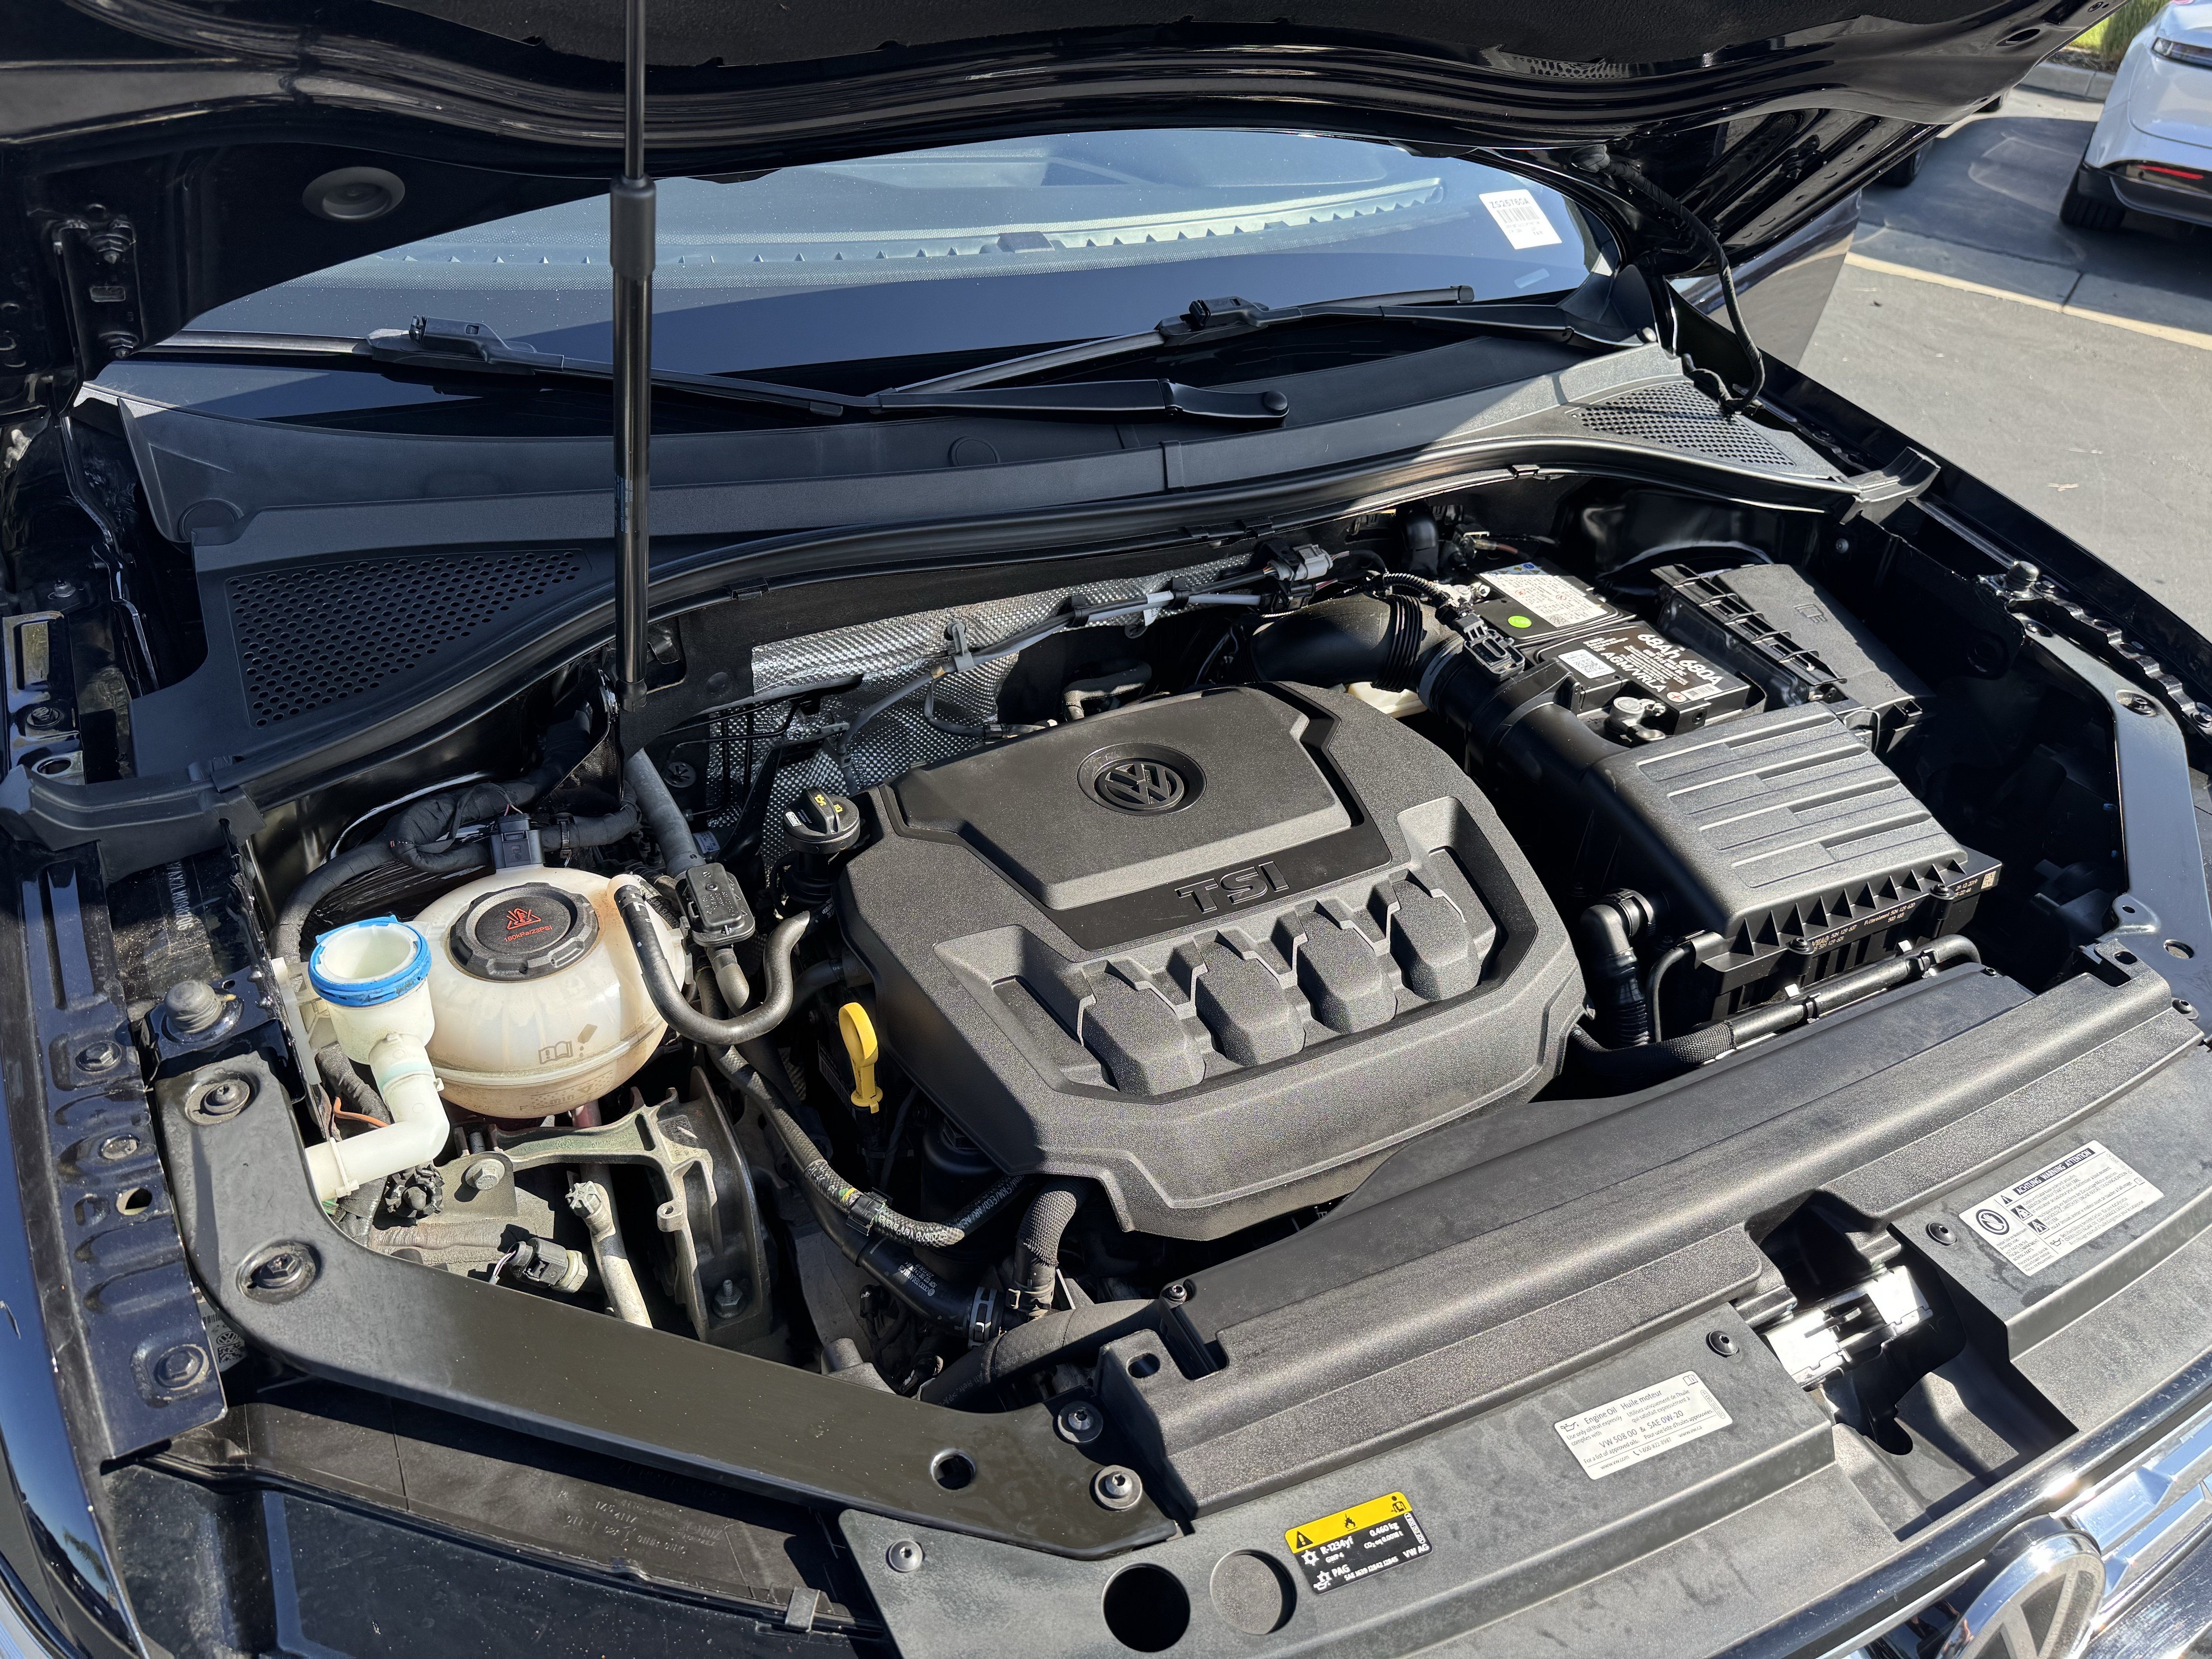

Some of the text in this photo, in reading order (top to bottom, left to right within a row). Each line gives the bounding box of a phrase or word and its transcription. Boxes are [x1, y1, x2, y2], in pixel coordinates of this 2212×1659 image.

[1637, 634, 1681, 659] 68Ah
[1679, 659, 1723, 686] 680A
[1600, 652, 1667, 692] AGM/VRLA
[1105, 761, 1184, 809] VW
[1175, 860, 1290, 914] TSI
[2016, 1177, 2042, 1194] ACHTUNG
[2040, 1164, 2066, 1179] WARNING
[2064, 1150, 2092, 1167] ATTENTION
[1620, 1390, 1661, 1410] Huile moteur
[1584, 1407, 1617, 1424] Engine Oil
[1599, 1438, 1613, 1448] VW
[1613, 1433, 1627, 1443] 508
[1627, 1429, 1637, 1437] 00
[1647, 1419, 1661, 1429] SAE
[1661, 1410, 1683, 1423] 0W-20
[1320, 1536, 1353, 1554] R-1234yf
[1402, 1543, 1429, 1558] VW AG
[1325, 1554, 1339, 1563] GWP
[1331, 1564, 1350, 1577] PAG
[1344, 1572, 1355, 1581] SAE
